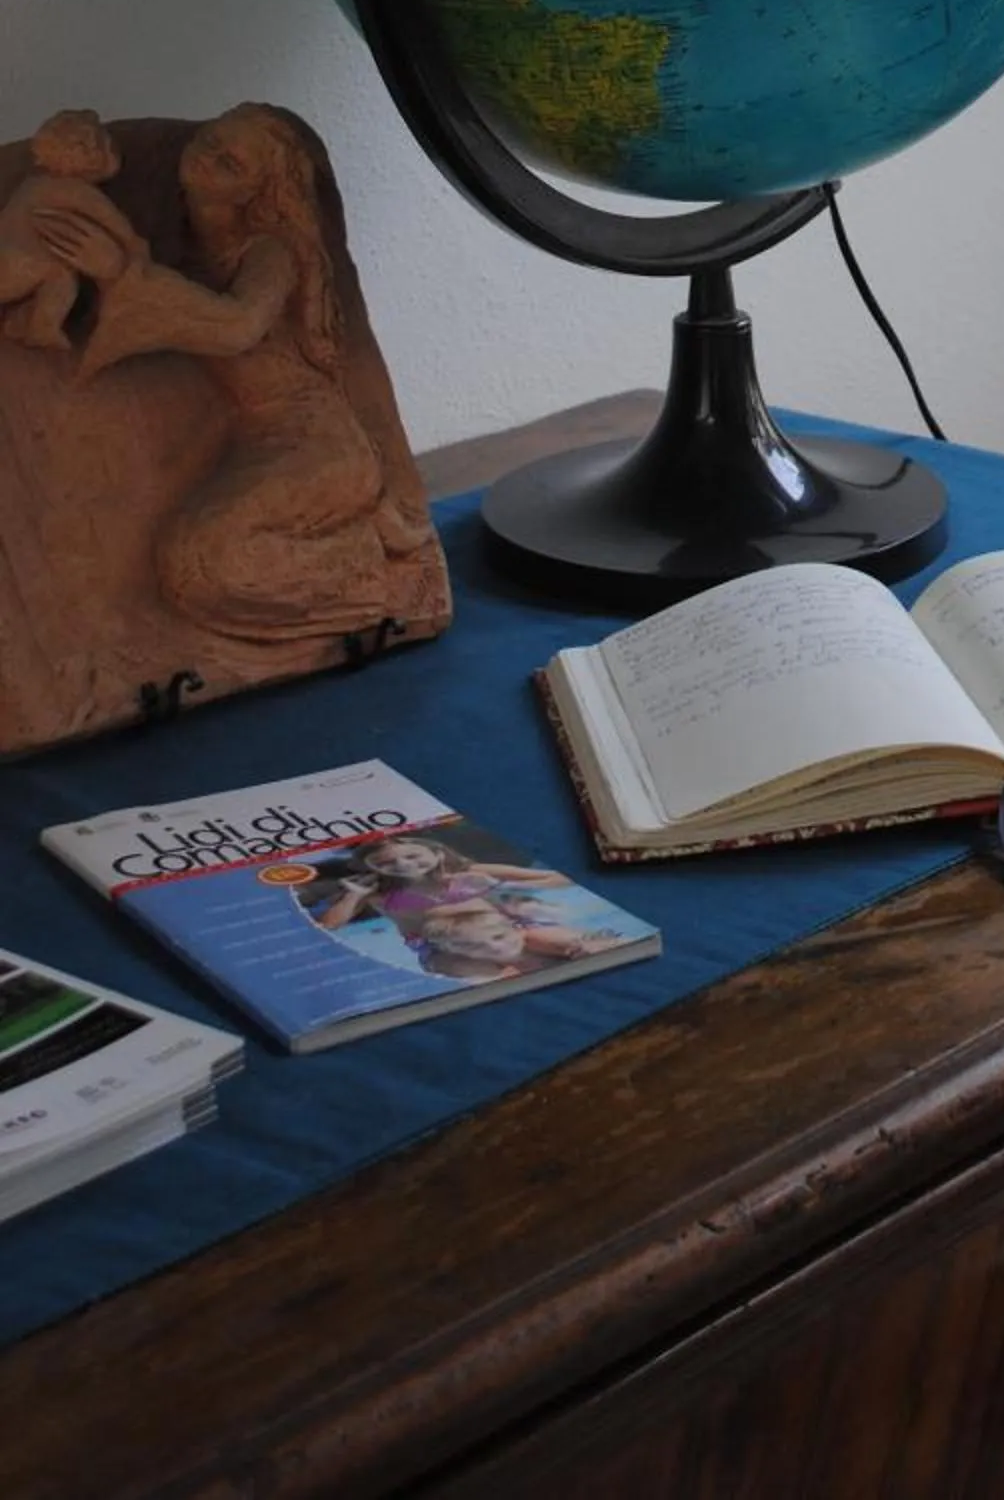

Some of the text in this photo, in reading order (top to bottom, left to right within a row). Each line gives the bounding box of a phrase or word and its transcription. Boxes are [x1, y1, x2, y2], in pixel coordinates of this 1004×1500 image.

[112, 809, 407, 877] Comacchio
[136, 817, 245, 855] Lidi
[251, 804, 307, 834] di
